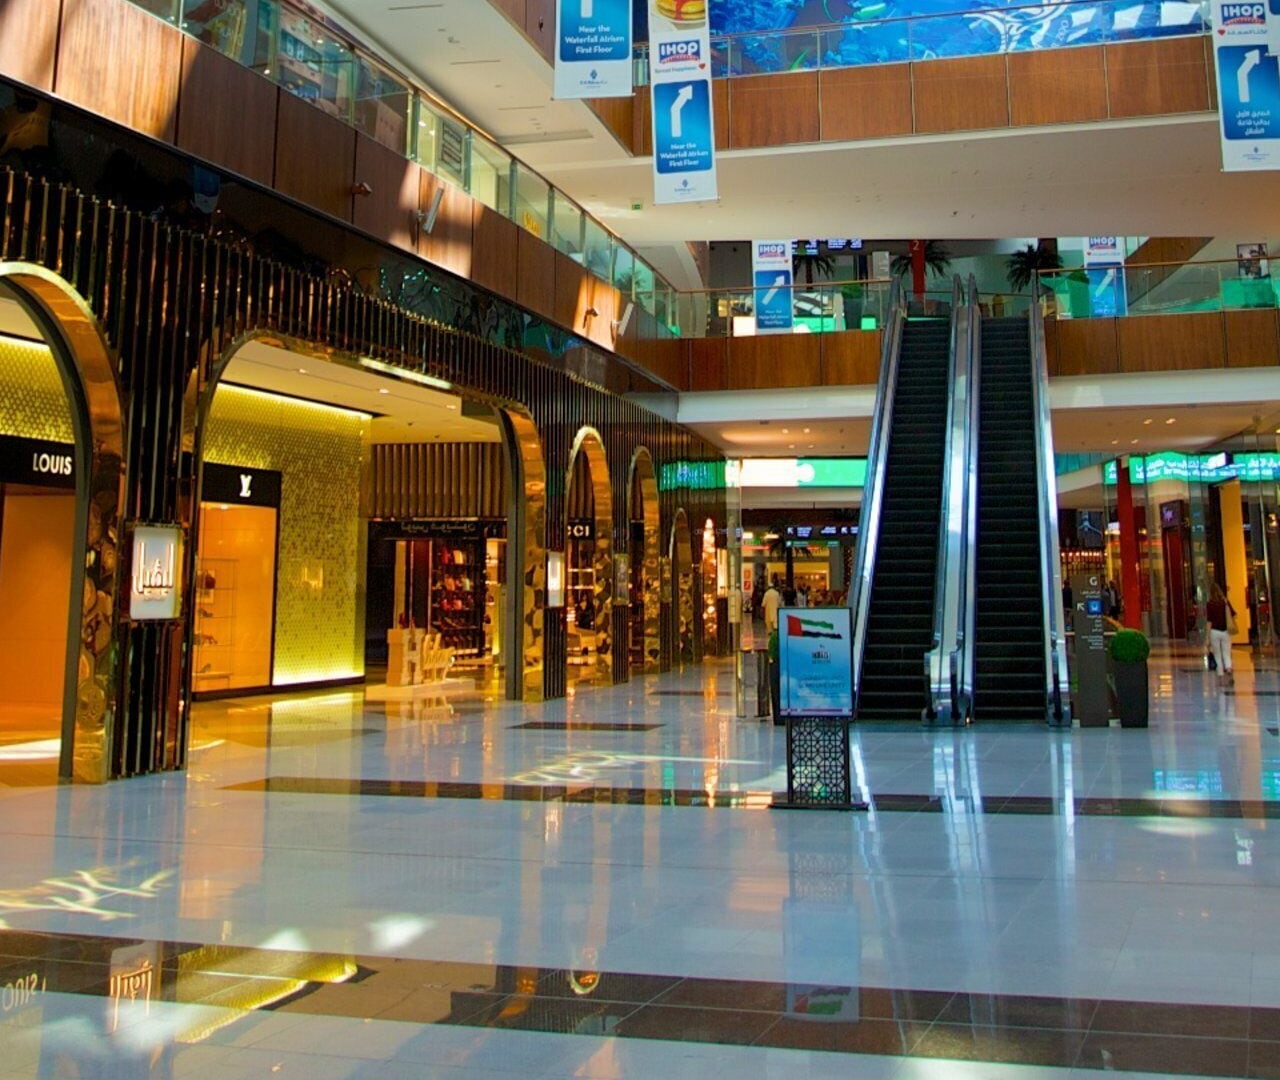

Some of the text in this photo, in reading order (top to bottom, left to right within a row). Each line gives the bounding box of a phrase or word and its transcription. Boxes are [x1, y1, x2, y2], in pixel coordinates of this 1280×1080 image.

[1223, 4, 1265, 19] IHOP
[578, 24, 611, 33] Near the
[565, 34, 625, 44] Waterfall Atrium
[575, 45, 613, 55] First Floor
[660, 41, 699, 56] IHOP
[1090, 236, 1115, 246] IHOP
[759, 244, 785, 254] IHOP
[33, 453, 72, 475] LOUIS
[1089, 576, 1098, 586] G
